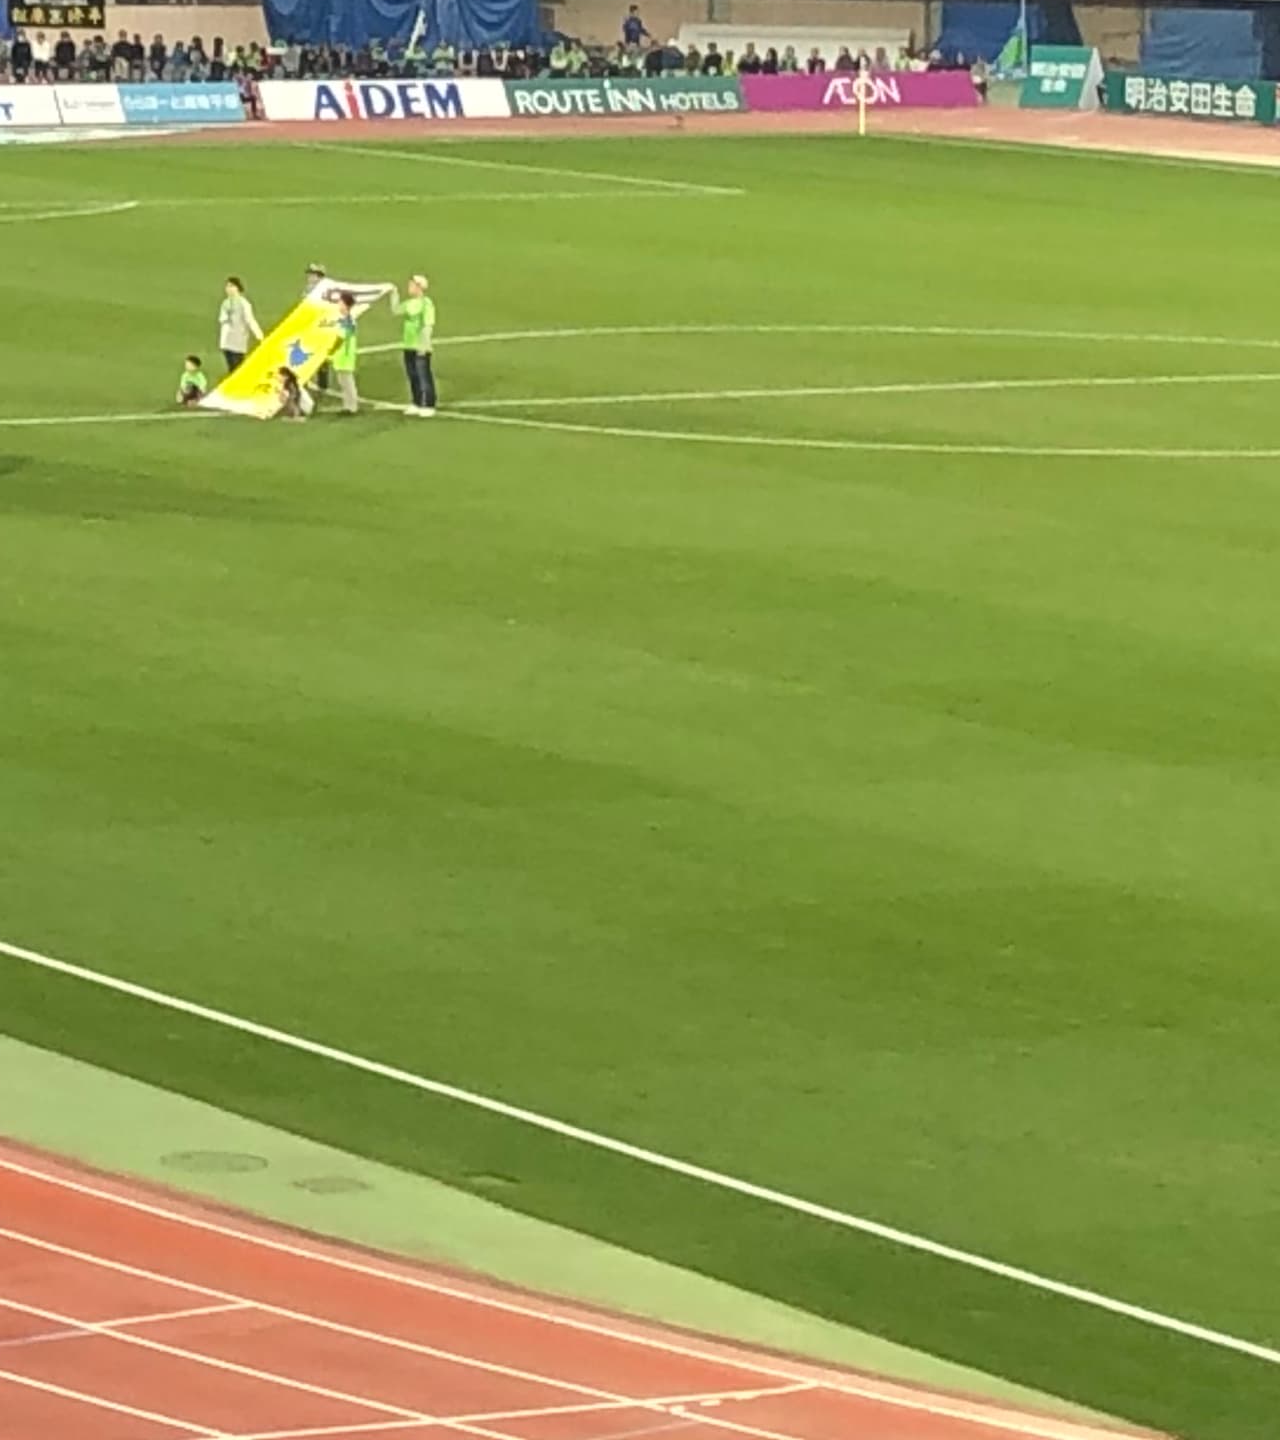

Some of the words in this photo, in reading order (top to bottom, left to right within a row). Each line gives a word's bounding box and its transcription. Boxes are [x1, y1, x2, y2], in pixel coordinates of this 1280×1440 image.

[516, 90, 604, 115] ROUTE
[659, 92, 738, 112] HOTELS
[1124, 77, 1257, 117] 明治安田生命
